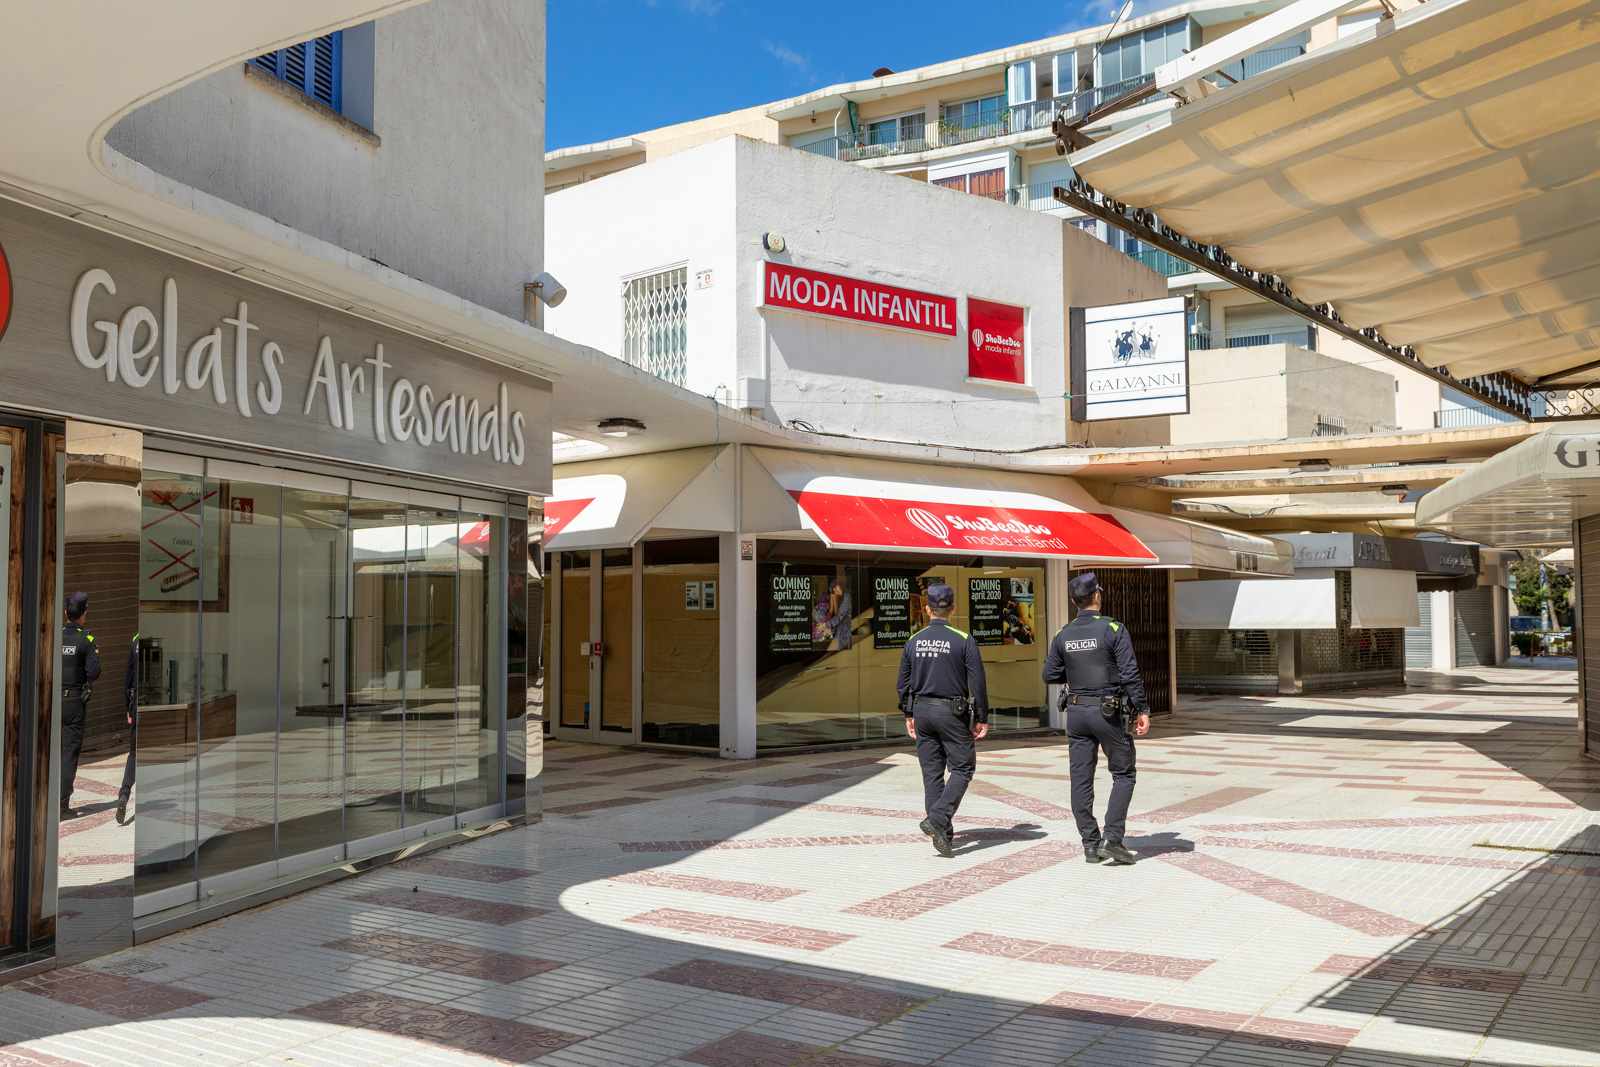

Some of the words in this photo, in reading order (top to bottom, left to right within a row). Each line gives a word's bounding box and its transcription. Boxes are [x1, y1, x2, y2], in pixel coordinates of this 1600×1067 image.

[769, 271, 847, 312] MODA
[853, 287, 953, 330] INFANTIL
[985, 333, 1021, 348] ShuBeeDoo
[985, 345, 1002, 353] moda
[1002, 345, 1021, 356] infantil
[71, 268, 285, 417] Gelats
[304, 335, 526, 466] Artesanals
[1090, 373, 1182, 392] GALVANNI
[945, 514, 1052, 535] ShuBeeDoo
[963, 534, 1013, 546] moda
[1011, 536, 1068, 549] infantil
[773, 577, 810, 590] COMING
[875, 578, 908, 590] COMING
[971, 579, 1001, 591] COMING
[773, 590, 792, 602] april
[792, 590, 811, 600] 2020
[876, 590, 892, 602] april
[892, 590, 909, 600] 2020
[971, 591, 986, 602] april
[986, 591, 1001, 600] 2020
[775, 633, 797, 641] Boutique
[877, 631, 897, 639] Boutique
[972, 629, 990, 637] Boutique
[916, 639, 951, 648] POLICIA
[1066, 641, 1096, 650] POLICIA
